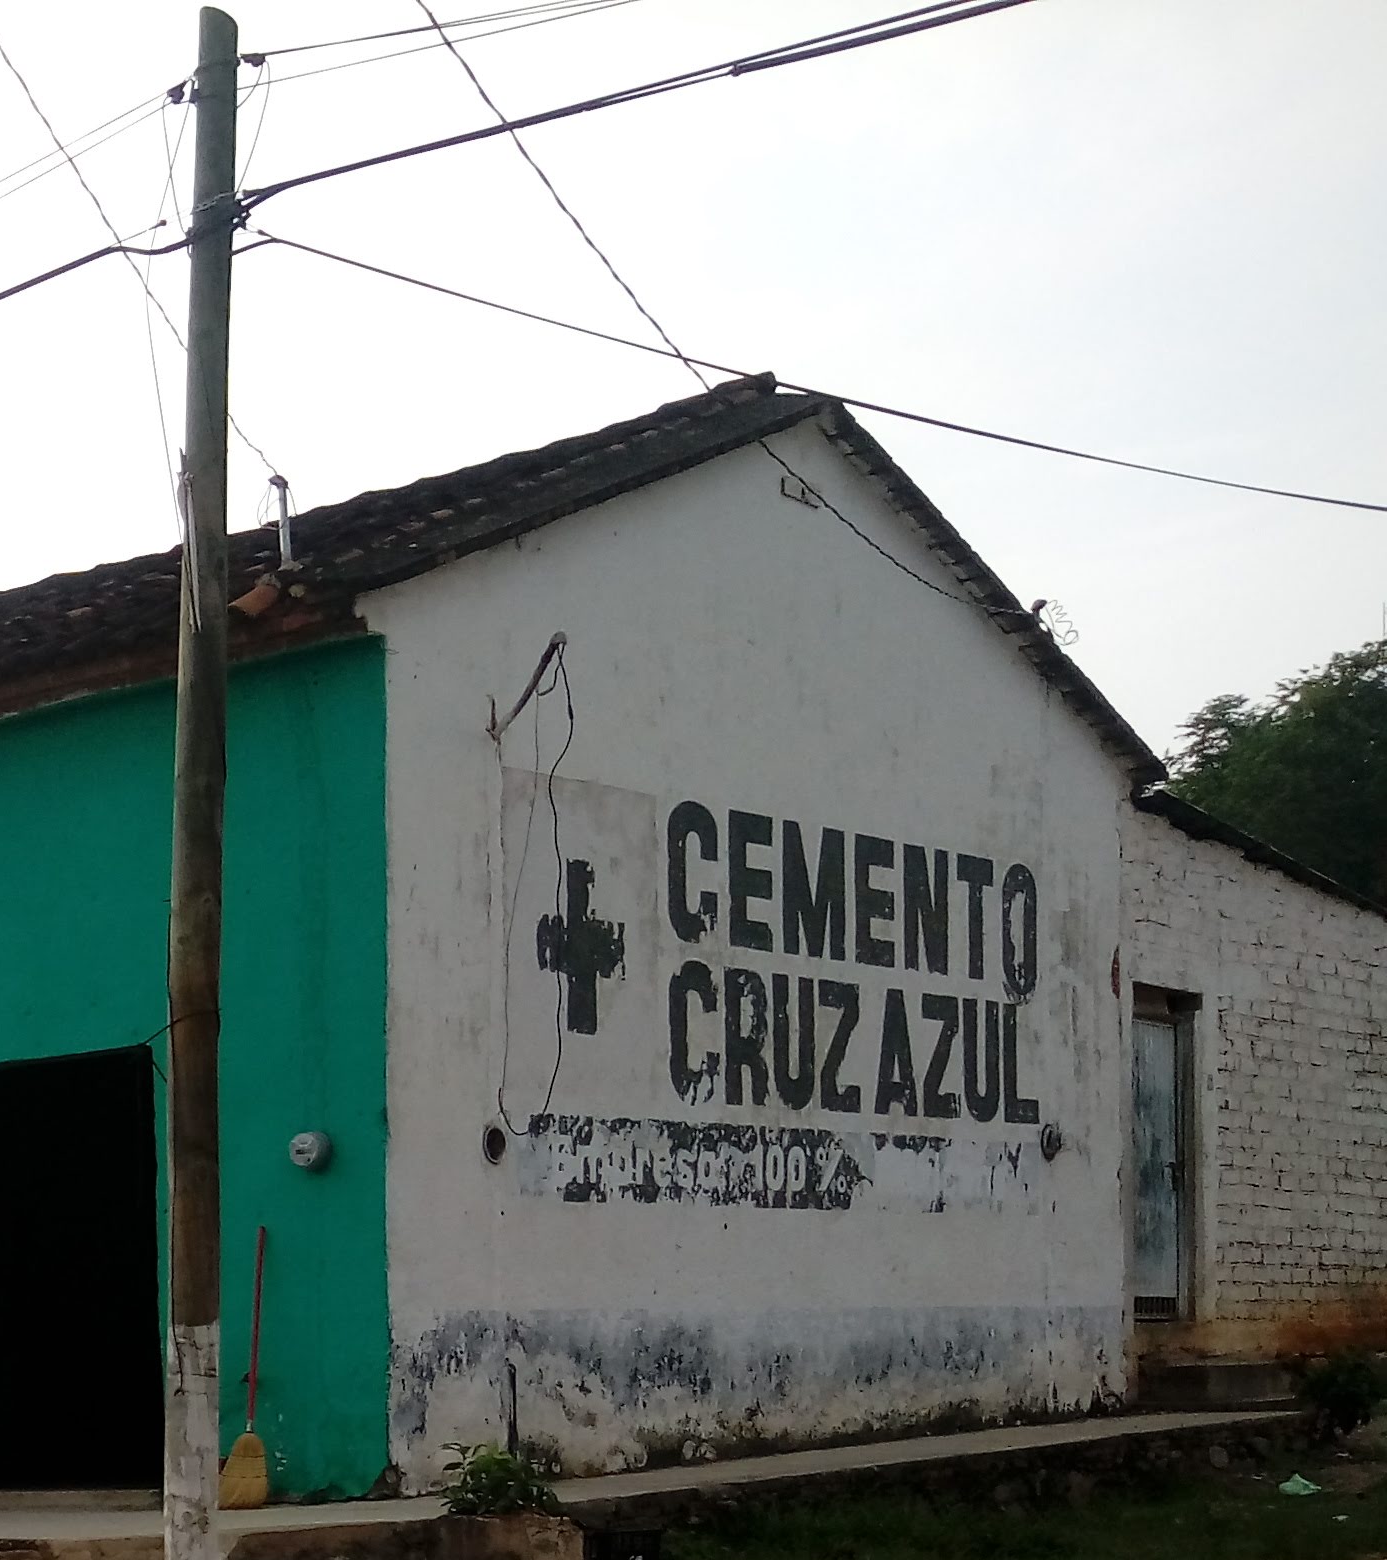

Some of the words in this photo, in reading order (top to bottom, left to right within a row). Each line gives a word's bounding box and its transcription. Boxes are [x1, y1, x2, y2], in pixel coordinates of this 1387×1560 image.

[667, 800, 1039, 1003] CEMENTO
[667, 960, 863, 1114] CRUZ
[875, 988, 1041, 1125] AZUL
